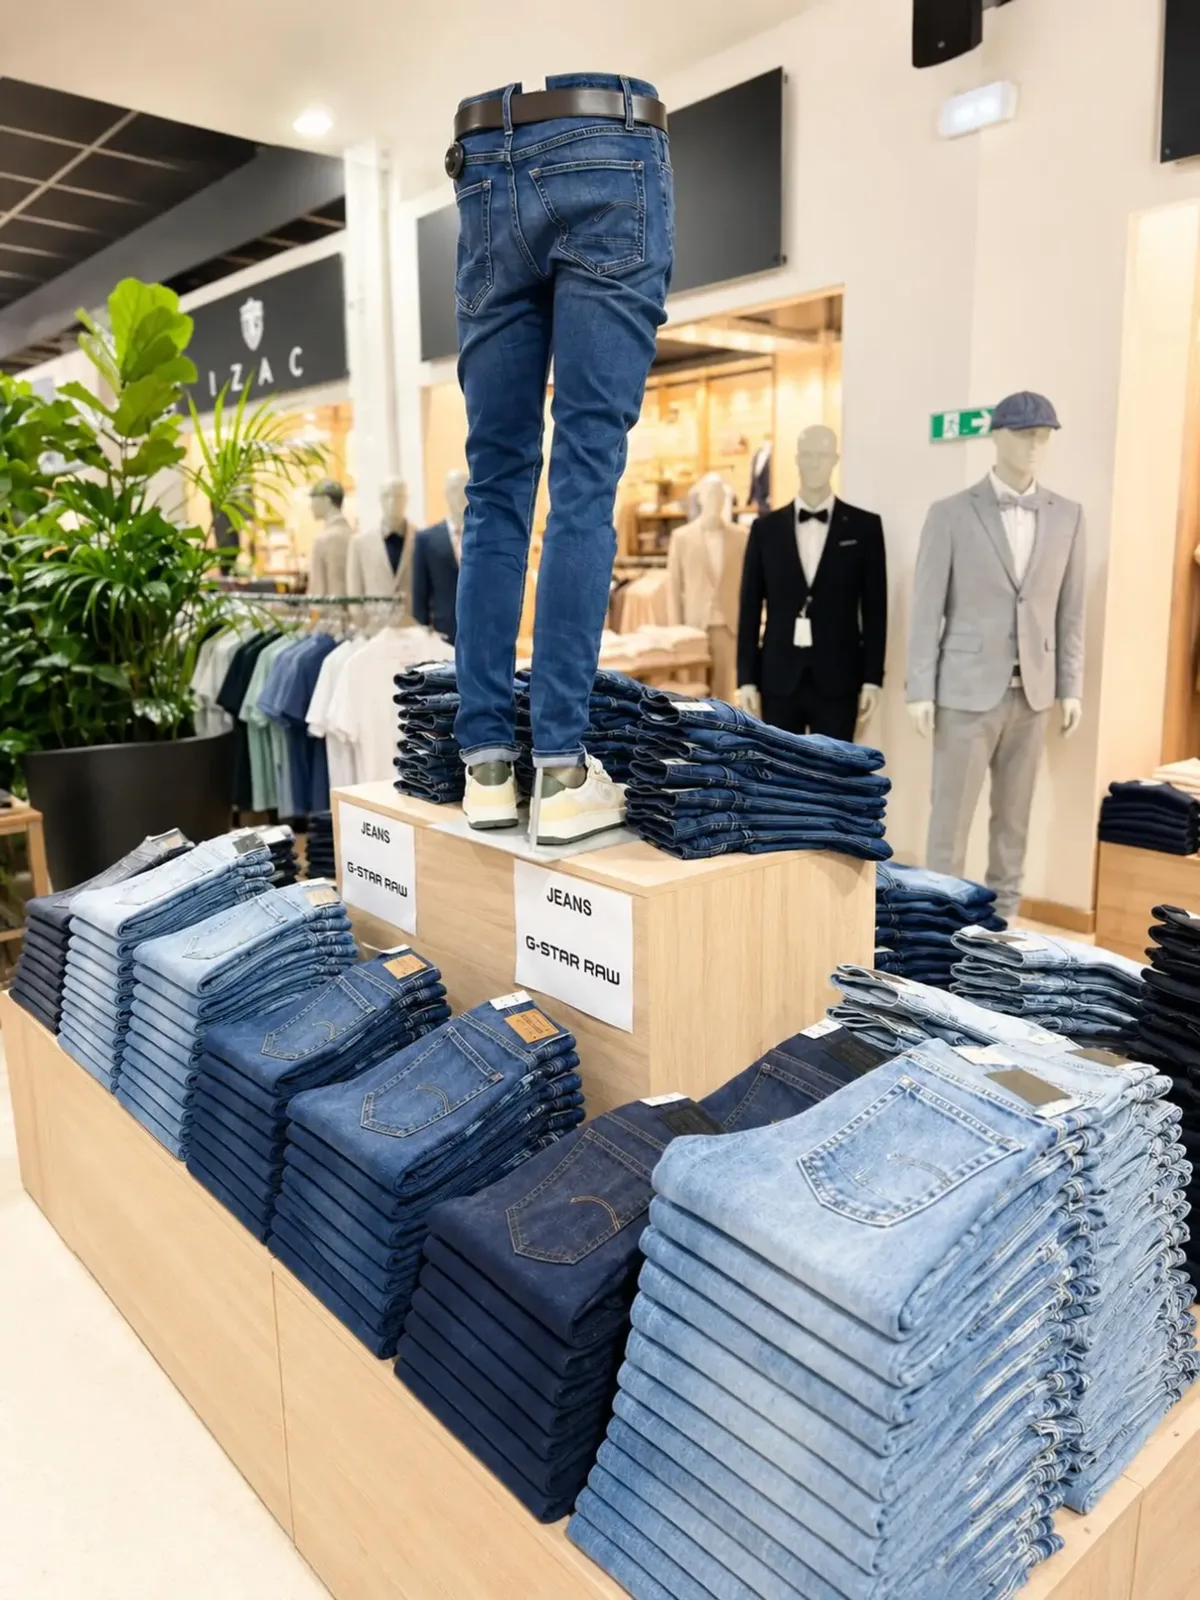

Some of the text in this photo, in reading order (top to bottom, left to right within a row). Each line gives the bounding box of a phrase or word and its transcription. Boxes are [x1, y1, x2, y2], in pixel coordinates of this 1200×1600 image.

[208, 346, 303, 397] IZAC
[361, 821, 391, 844] JEANS
[347, 861, 408, 898] G-STAR RAW
[546, 887, 592, 916] JEANS
[525, 935, 620, 986] G-STAR RAW
